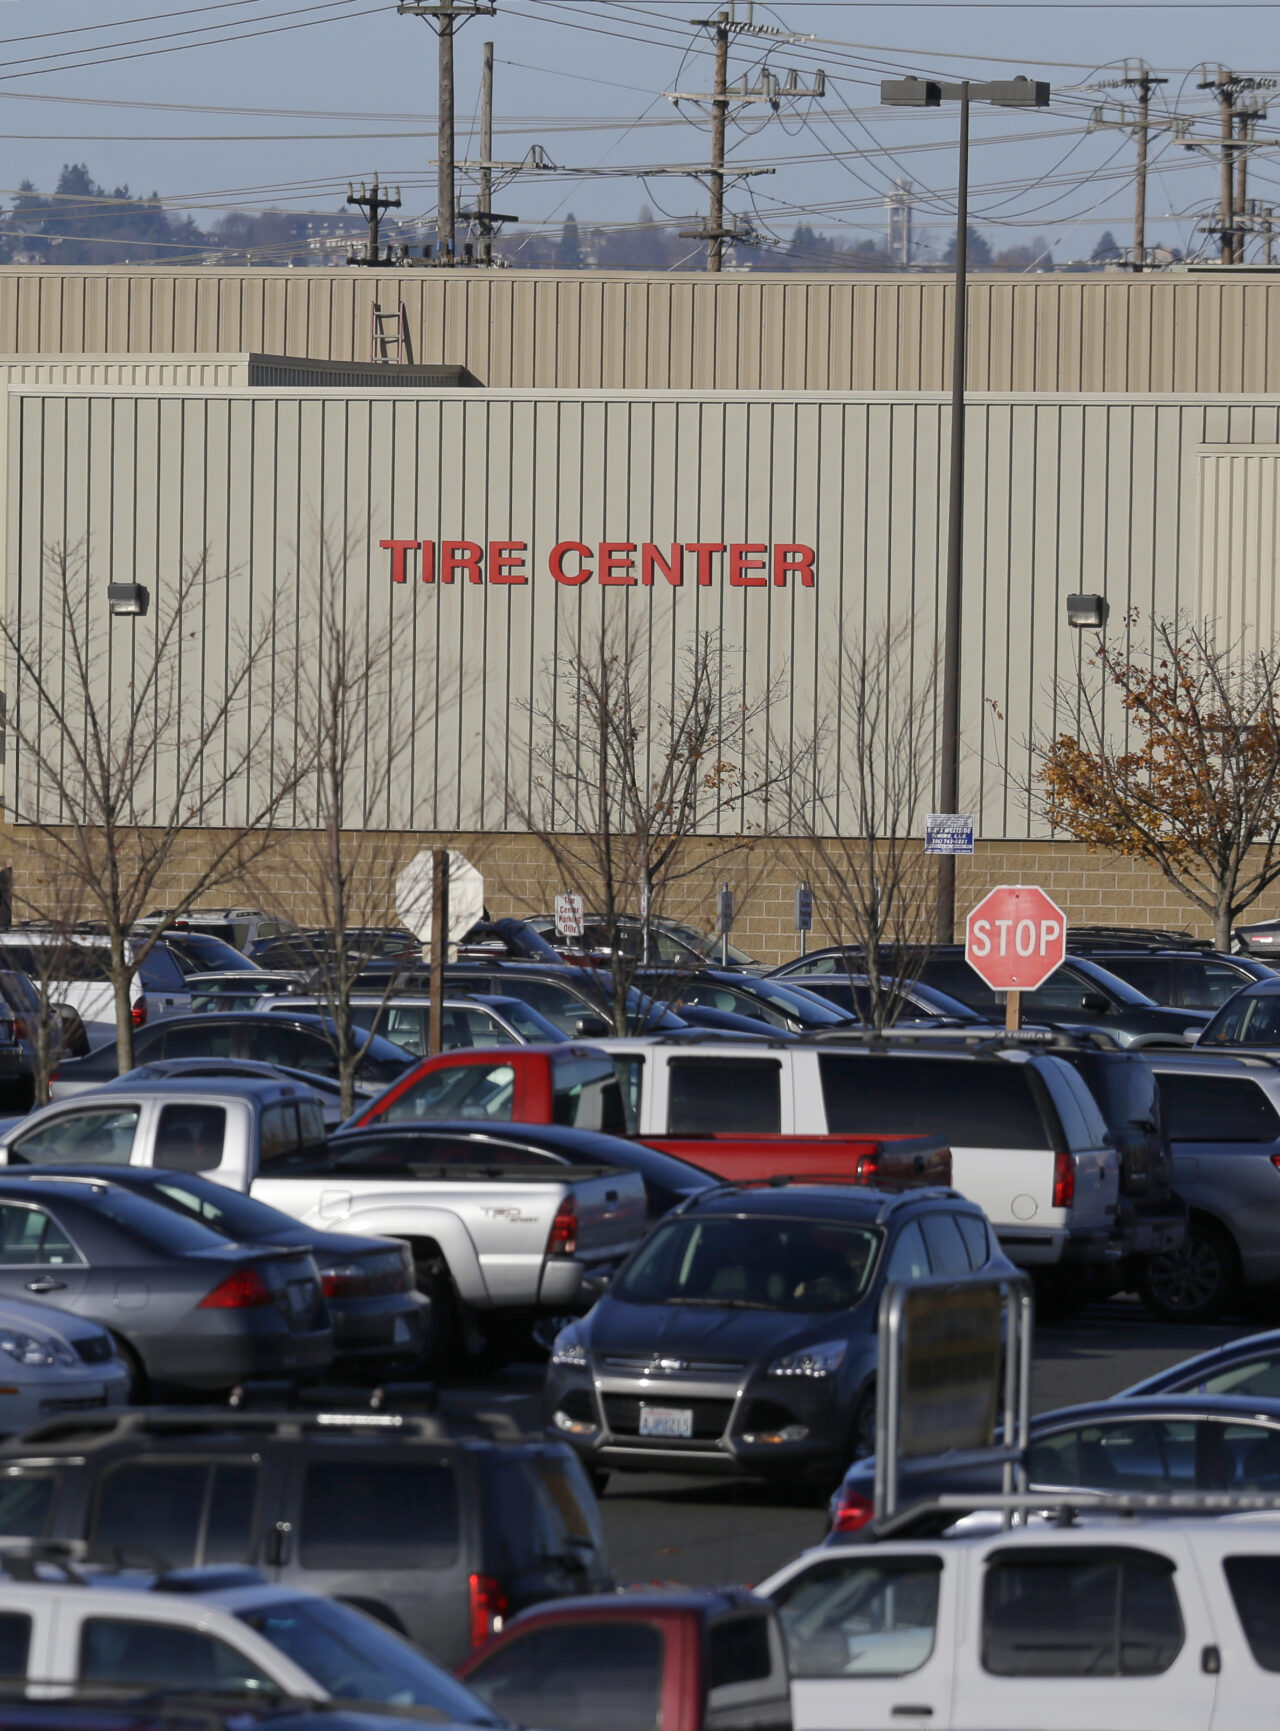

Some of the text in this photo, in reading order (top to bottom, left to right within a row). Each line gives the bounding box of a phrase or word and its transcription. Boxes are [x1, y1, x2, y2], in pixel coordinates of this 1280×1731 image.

[379, 539, 816, 587] TIRE CENTER
[972, 919, 1060, 957] STOP
[480, 1206, 521, 1219] TRD
